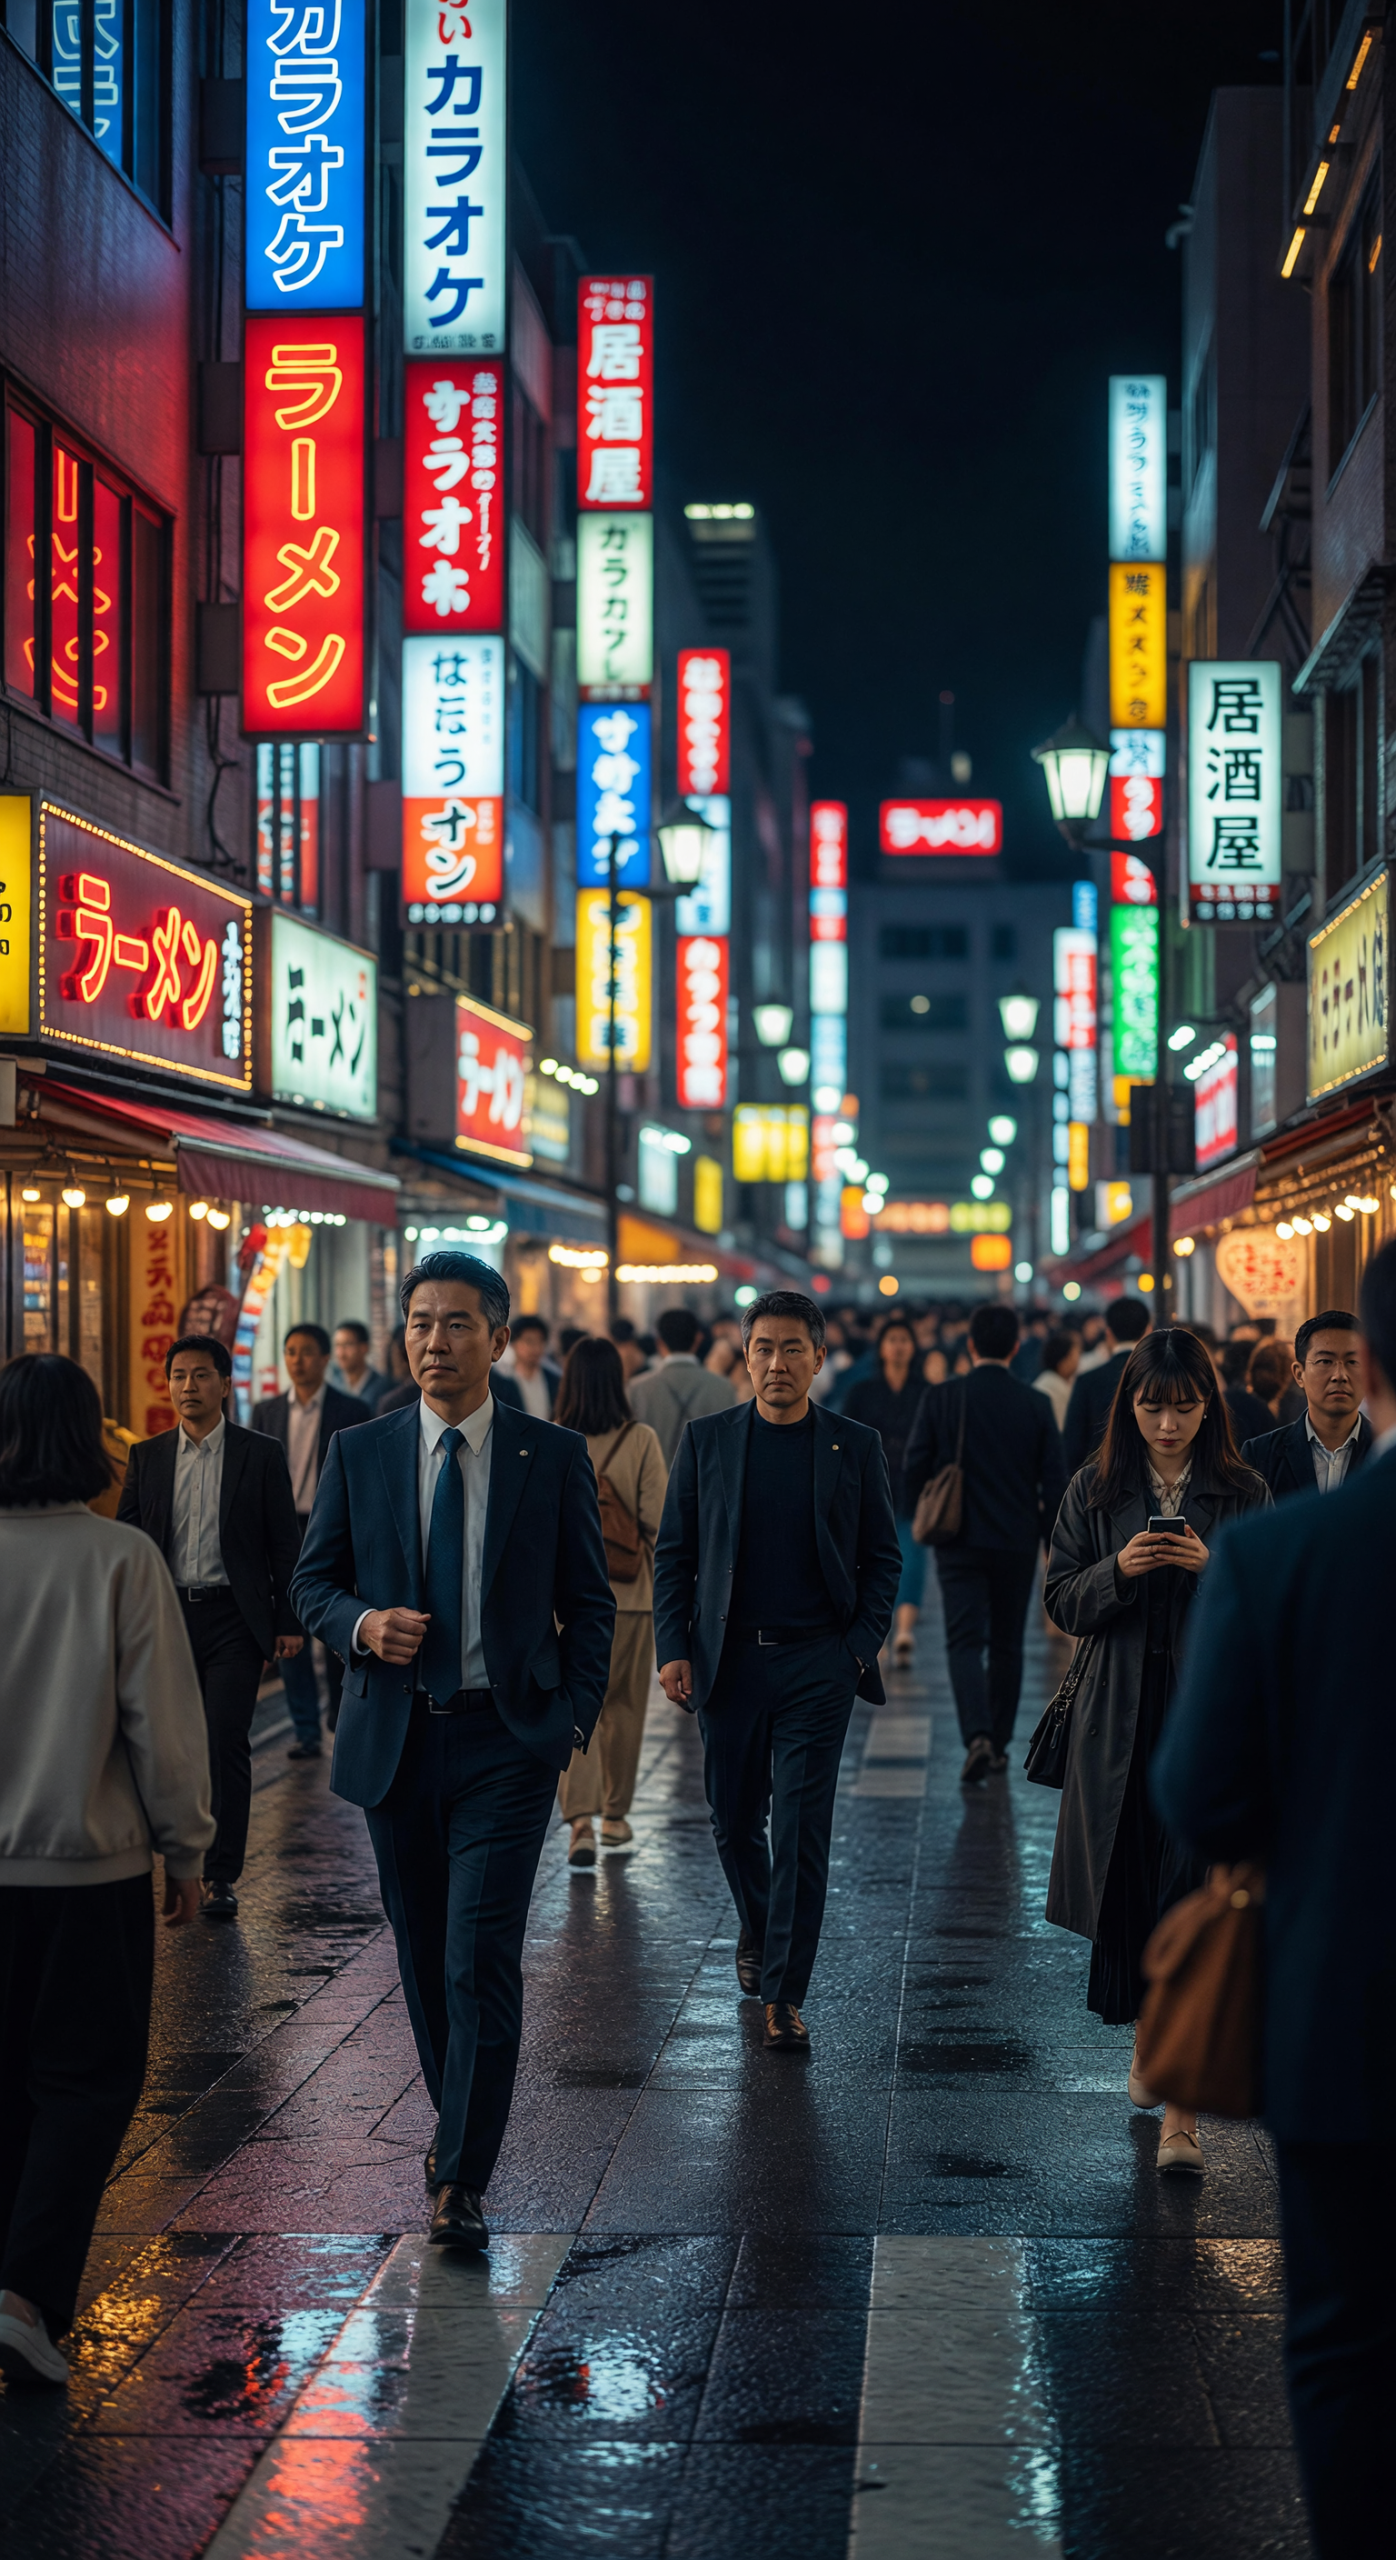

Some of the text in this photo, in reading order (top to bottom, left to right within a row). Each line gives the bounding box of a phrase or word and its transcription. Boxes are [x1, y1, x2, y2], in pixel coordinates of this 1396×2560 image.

[437, 0, 472, 45] い
[423, 54, 485, 328] カラオケ
[585, 323, 644, 502] 居酒屋
[264, 343, 347, 709] ラーメン
[1206, 678, 1264, 871] 居酒屋
[66, 872, 218, 1031] ラーメン
